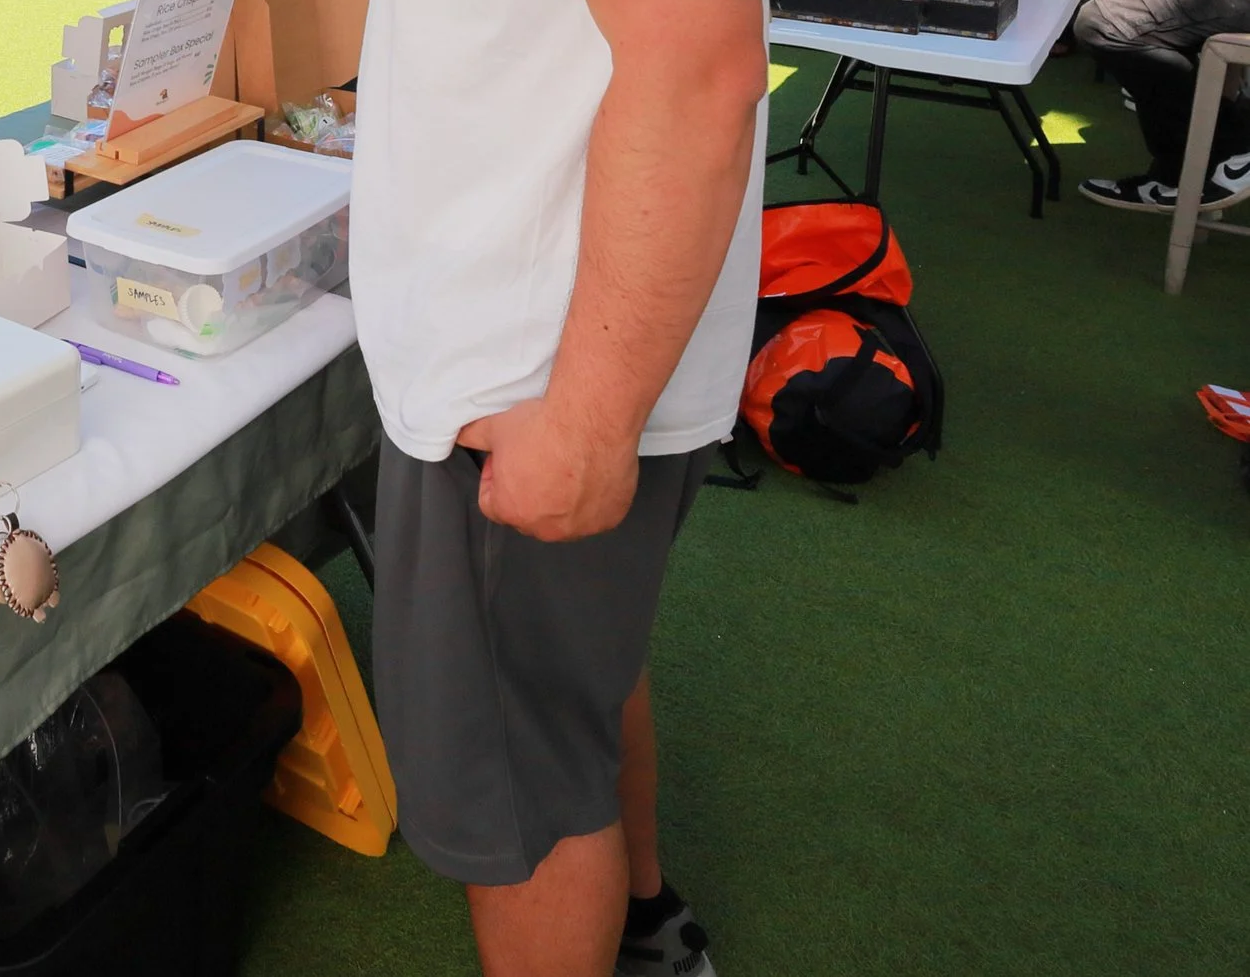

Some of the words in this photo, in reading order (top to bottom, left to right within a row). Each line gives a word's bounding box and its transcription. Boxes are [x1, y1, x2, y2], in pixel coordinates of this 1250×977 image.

[157, 3, 176, 16] Rice
[134, 49, 170, 70] Sampler
[169, 44, 184, 56] Box
[184, 31, 214, 50] Special
[127, 287, 166, 306] SAMPLES
